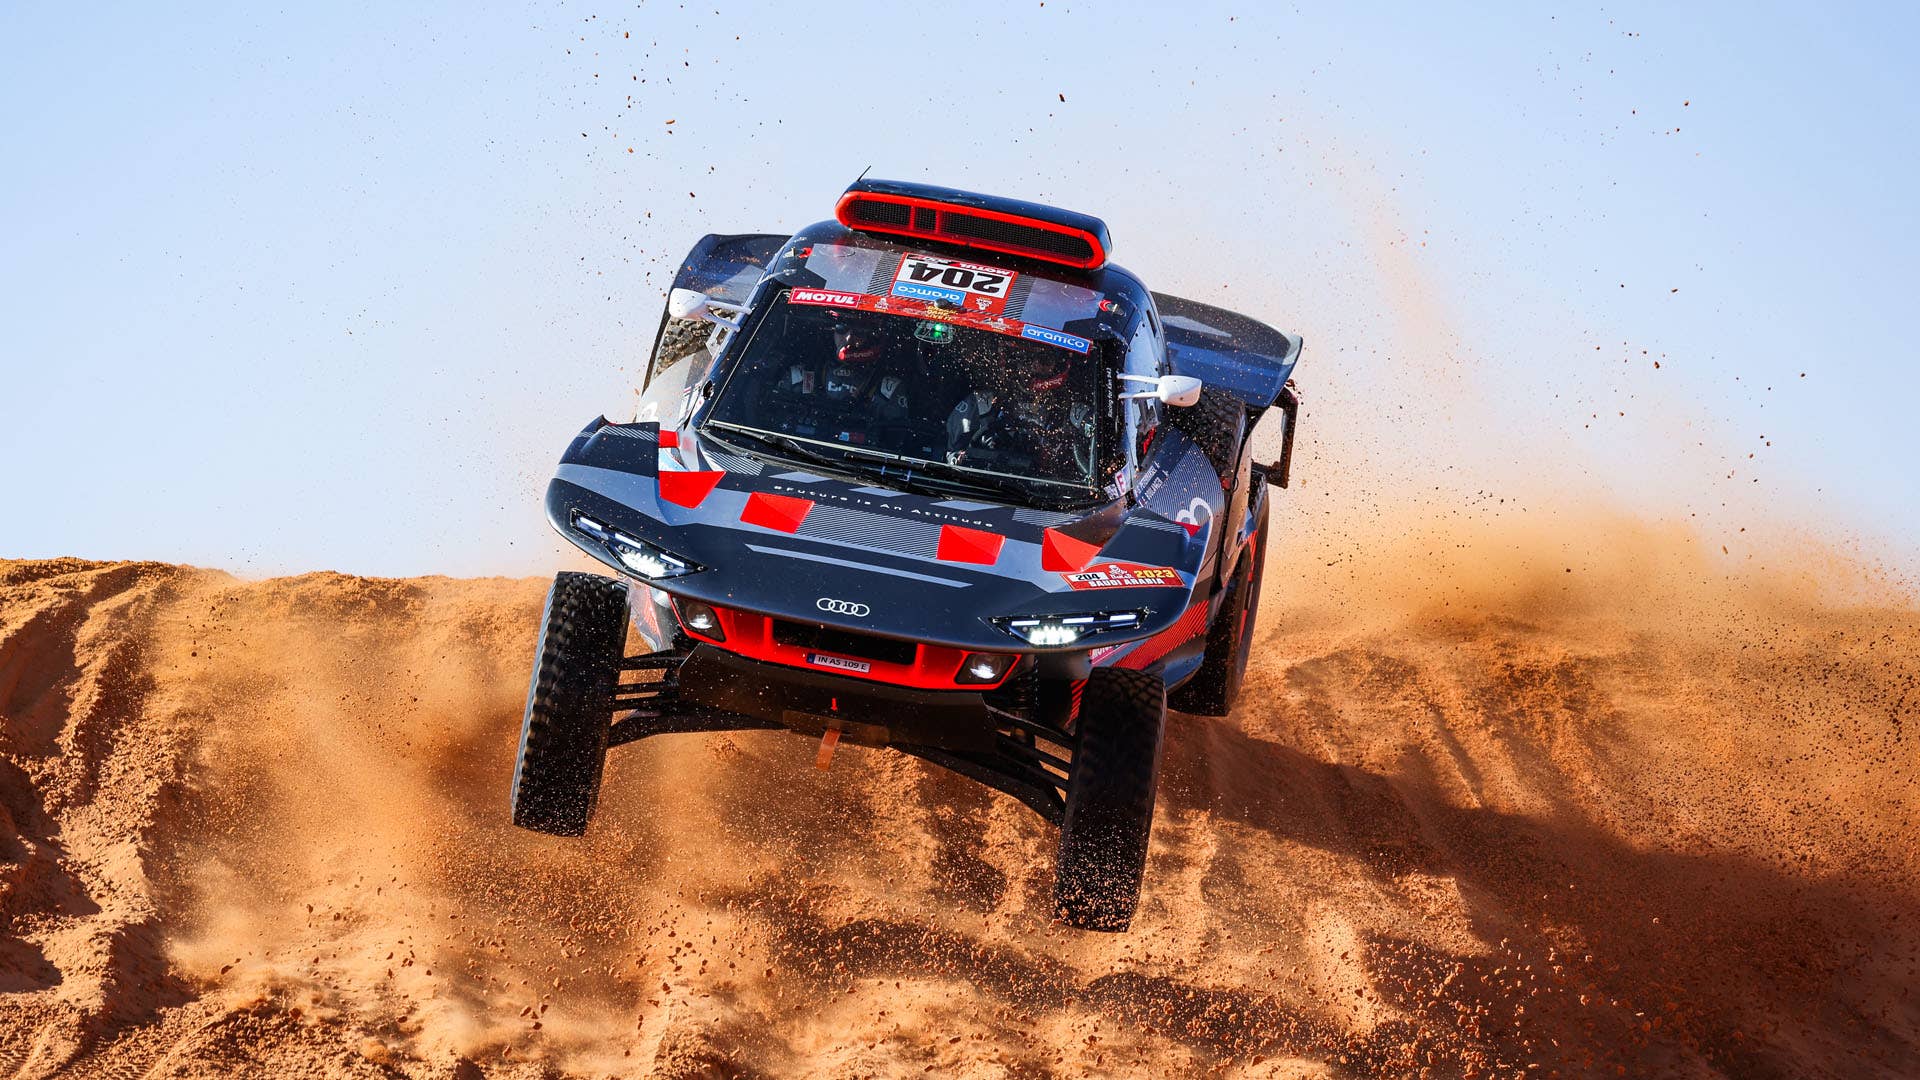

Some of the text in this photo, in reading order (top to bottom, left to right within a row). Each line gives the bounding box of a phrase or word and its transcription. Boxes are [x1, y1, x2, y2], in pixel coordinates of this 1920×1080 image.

[908, 261, 1005, 294] 204
[796, 291, 856, 305] MOTUL
[897, 285, 961, 301] aramco
[1026, 327, 1086, 349] aramco
[880, 503, 902, 511] An
[911, 508, 993, 527] Attitude
[1075, 573, 1101, 581] 204
[1133, 569, 1176, 579] 2023
[1088, 577, 1166, 588] SAUDI ARABIA
[818, 656, 867, 671] IN AS 109 E
